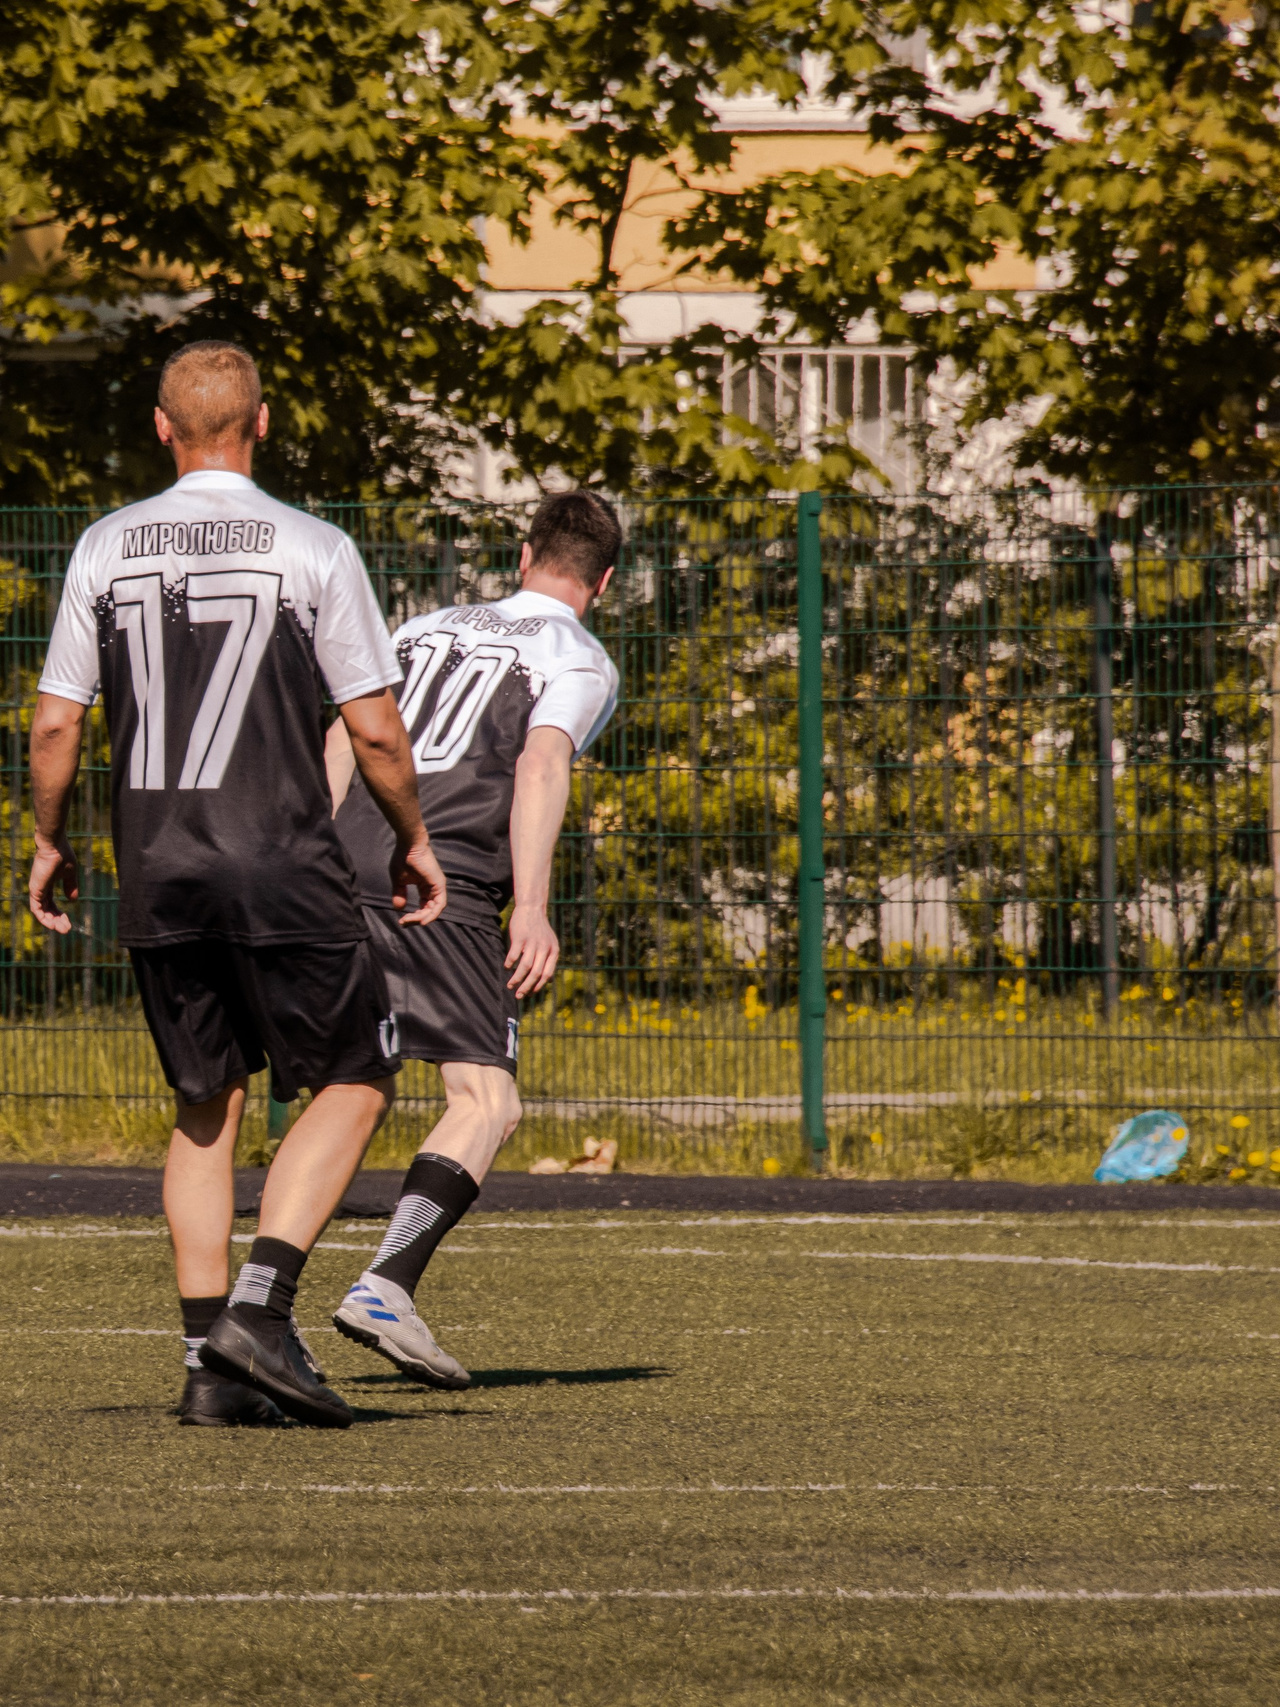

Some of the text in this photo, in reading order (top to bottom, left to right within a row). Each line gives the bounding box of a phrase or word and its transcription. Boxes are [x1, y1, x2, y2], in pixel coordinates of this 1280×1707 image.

[122, 520, 275, 559] МИРОЛЮБОВ
[111, 569, 282, 790] 17
[397, 631, 519, 774] 10
